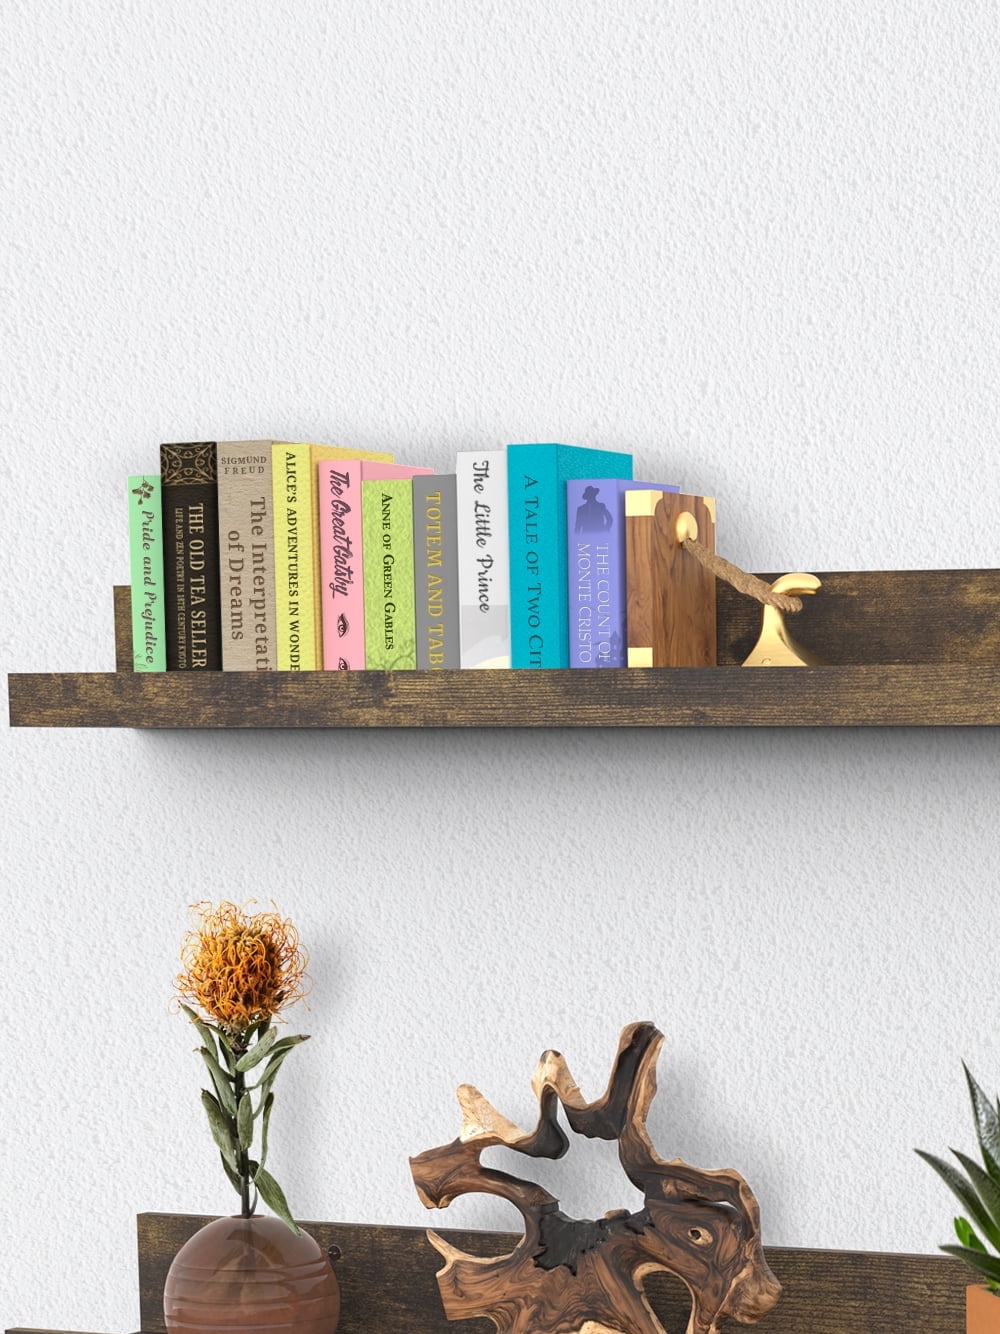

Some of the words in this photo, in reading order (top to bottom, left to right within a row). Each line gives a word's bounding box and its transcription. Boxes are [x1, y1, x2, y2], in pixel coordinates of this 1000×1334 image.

[221, 456, 267, 464] SIGMUND
[224, 466, 264, 474] FREUD
[286, 452, 296, 503] ALICE'S
[329, 470, 350, 497] The
[472, 460, 489, 495] The
[524, 476, 538, 490] A
[142, 510, 154, 550] Pride
[175, 508, 184, 523] LIFE
[188, 503, 204, 534] THE
[250, 497, 266, 536] The
[331, 499, 353, 546] Great
[426, 491, 443, 567] TOTEM
[474, 500, 490, 548] Little
[176, 524, 184, 540] AND
[227, 530, 245, 552] of
[176, 542, 184, 554] ZEN
[189, 539, 205, 570] OLD
[286, 508, 298, 596] ADVENTURES
[596, 544, 610, 575] THE
[143, 556, 153, 585] and
[176, 556, 185, 582] POETRY
[328, 545, 354, 600] Gatsby
[476, 553, 494, 614] Prince
[577, 544, 591, 601] MONTE
[177, 584, 186, 592] IN
[190, 576, 206, 606] TEA
[229, 558, 244, 640] Dreams
[427, 574, 443, 617] AND
[289, 602, 299, 616] IN
[597, 580, 611, 639] COUNT
[140, 592, 158, 664] Prejudice
[177, 613, 186, 644] CENTURY
[191, 610, 208, 668] SELLER
[578, 606, 592, 662] CRISTO
[178, 646, 187, 668] KYOTO
[428, 624, 445, 670] TAB
[598, 642, 612, 662] OF
